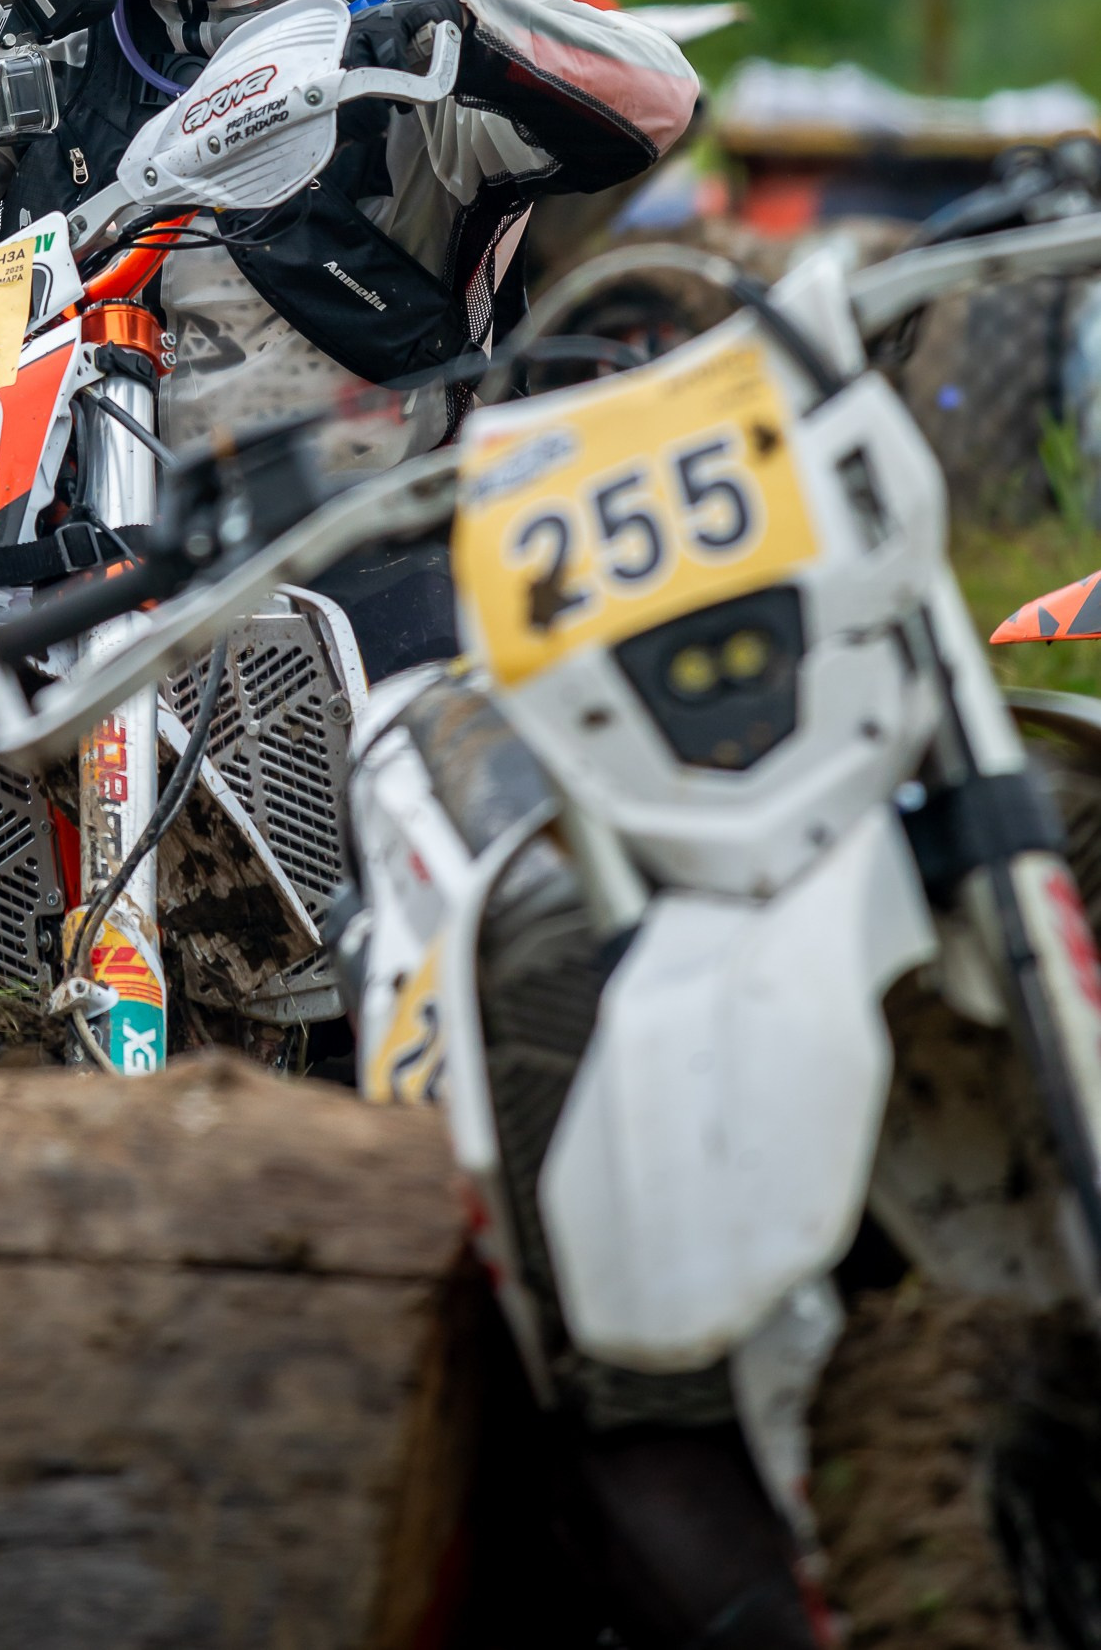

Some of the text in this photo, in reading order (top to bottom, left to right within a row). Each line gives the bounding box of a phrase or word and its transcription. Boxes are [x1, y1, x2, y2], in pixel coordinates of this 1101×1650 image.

[224, 110, 290, 148] FOR ENDURO
[225, 95, 289, 134] PROTECTION
[5, 264, 25, 276] 2025
[511, 435, 753, 630] 255
